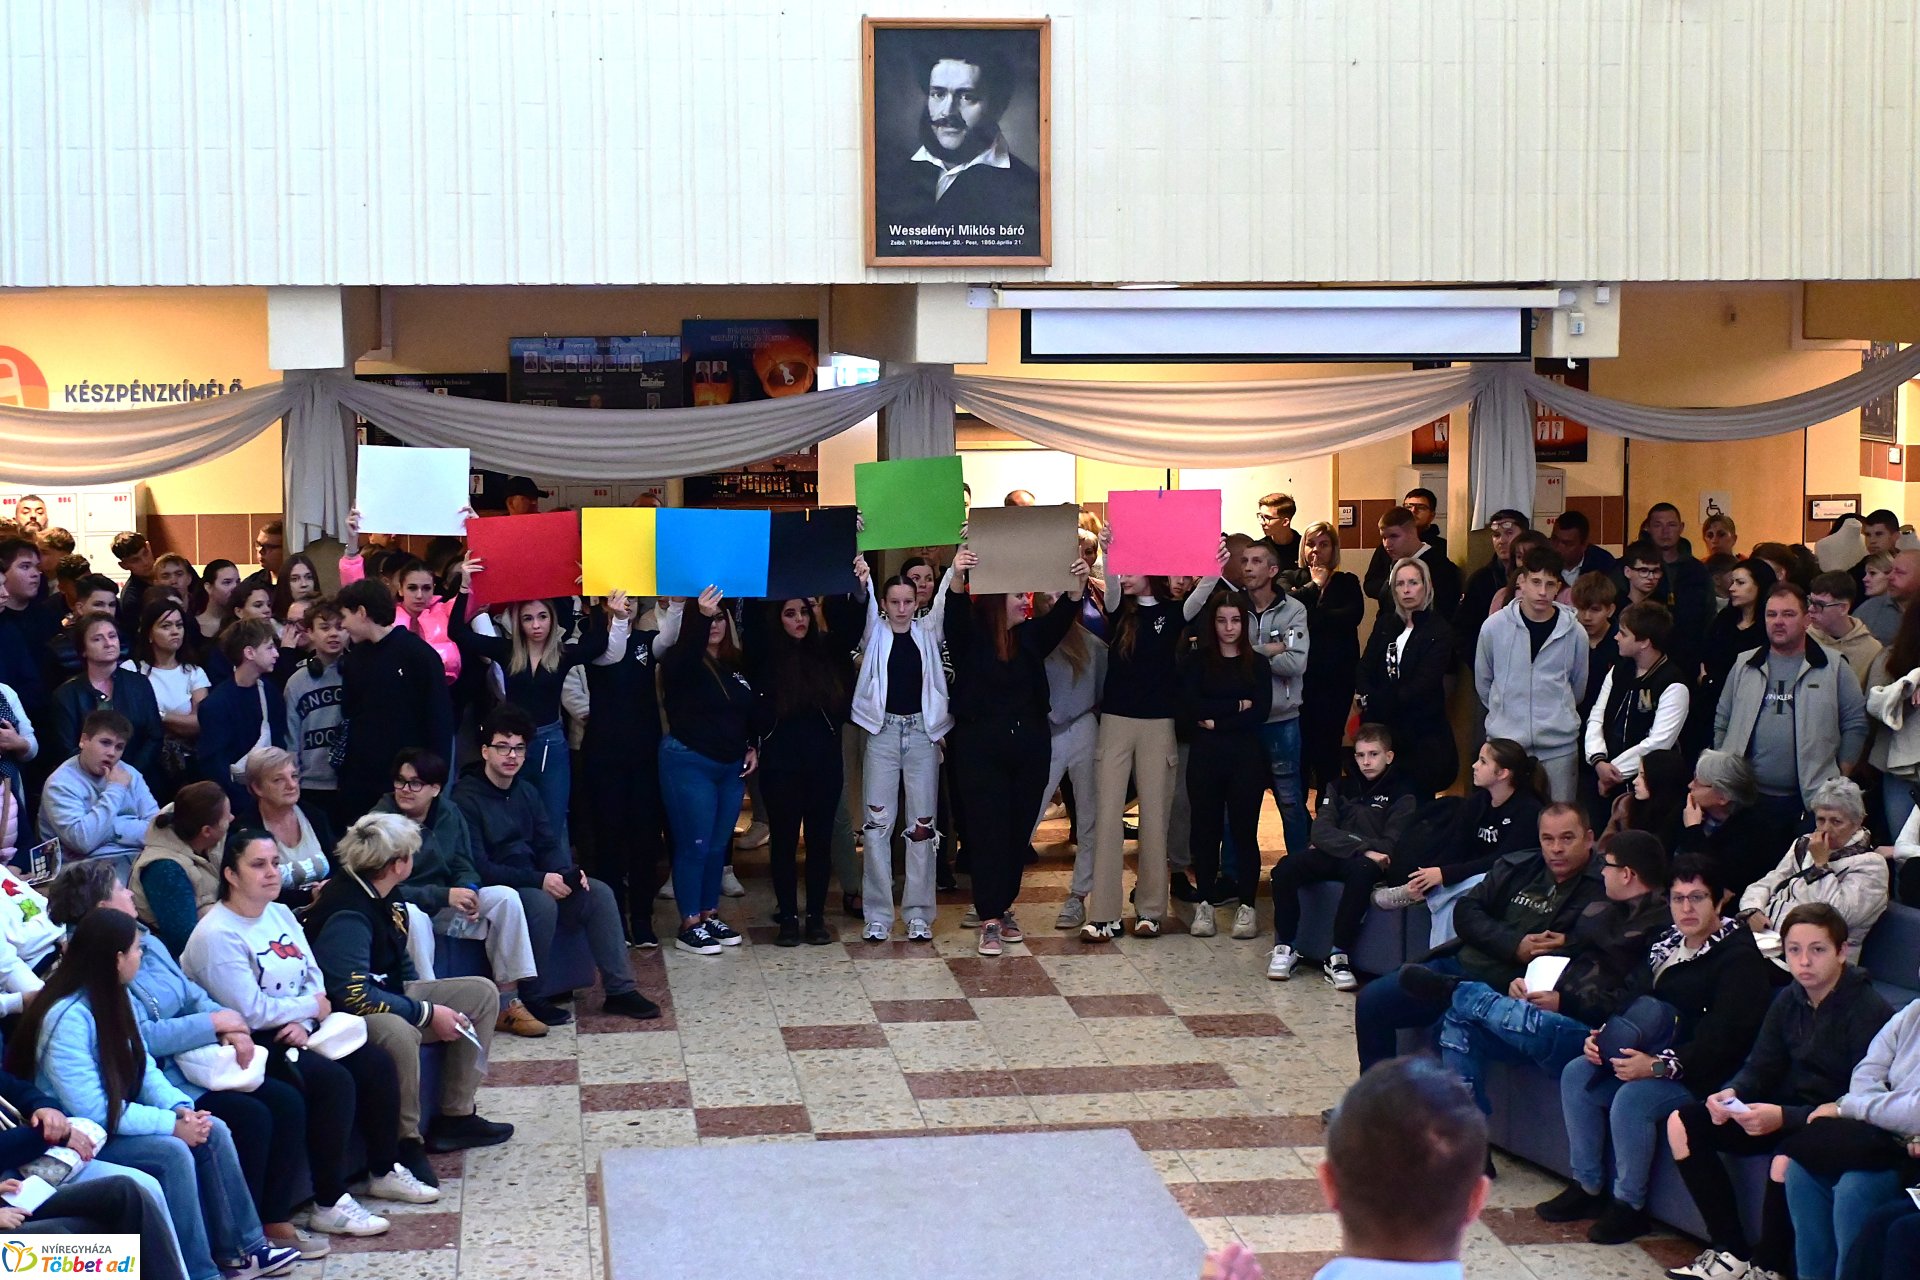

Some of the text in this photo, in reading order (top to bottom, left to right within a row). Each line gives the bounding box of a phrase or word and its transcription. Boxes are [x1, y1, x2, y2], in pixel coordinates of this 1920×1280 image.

[889, 224, 1025, 238] Wesselényi Miklós báró
